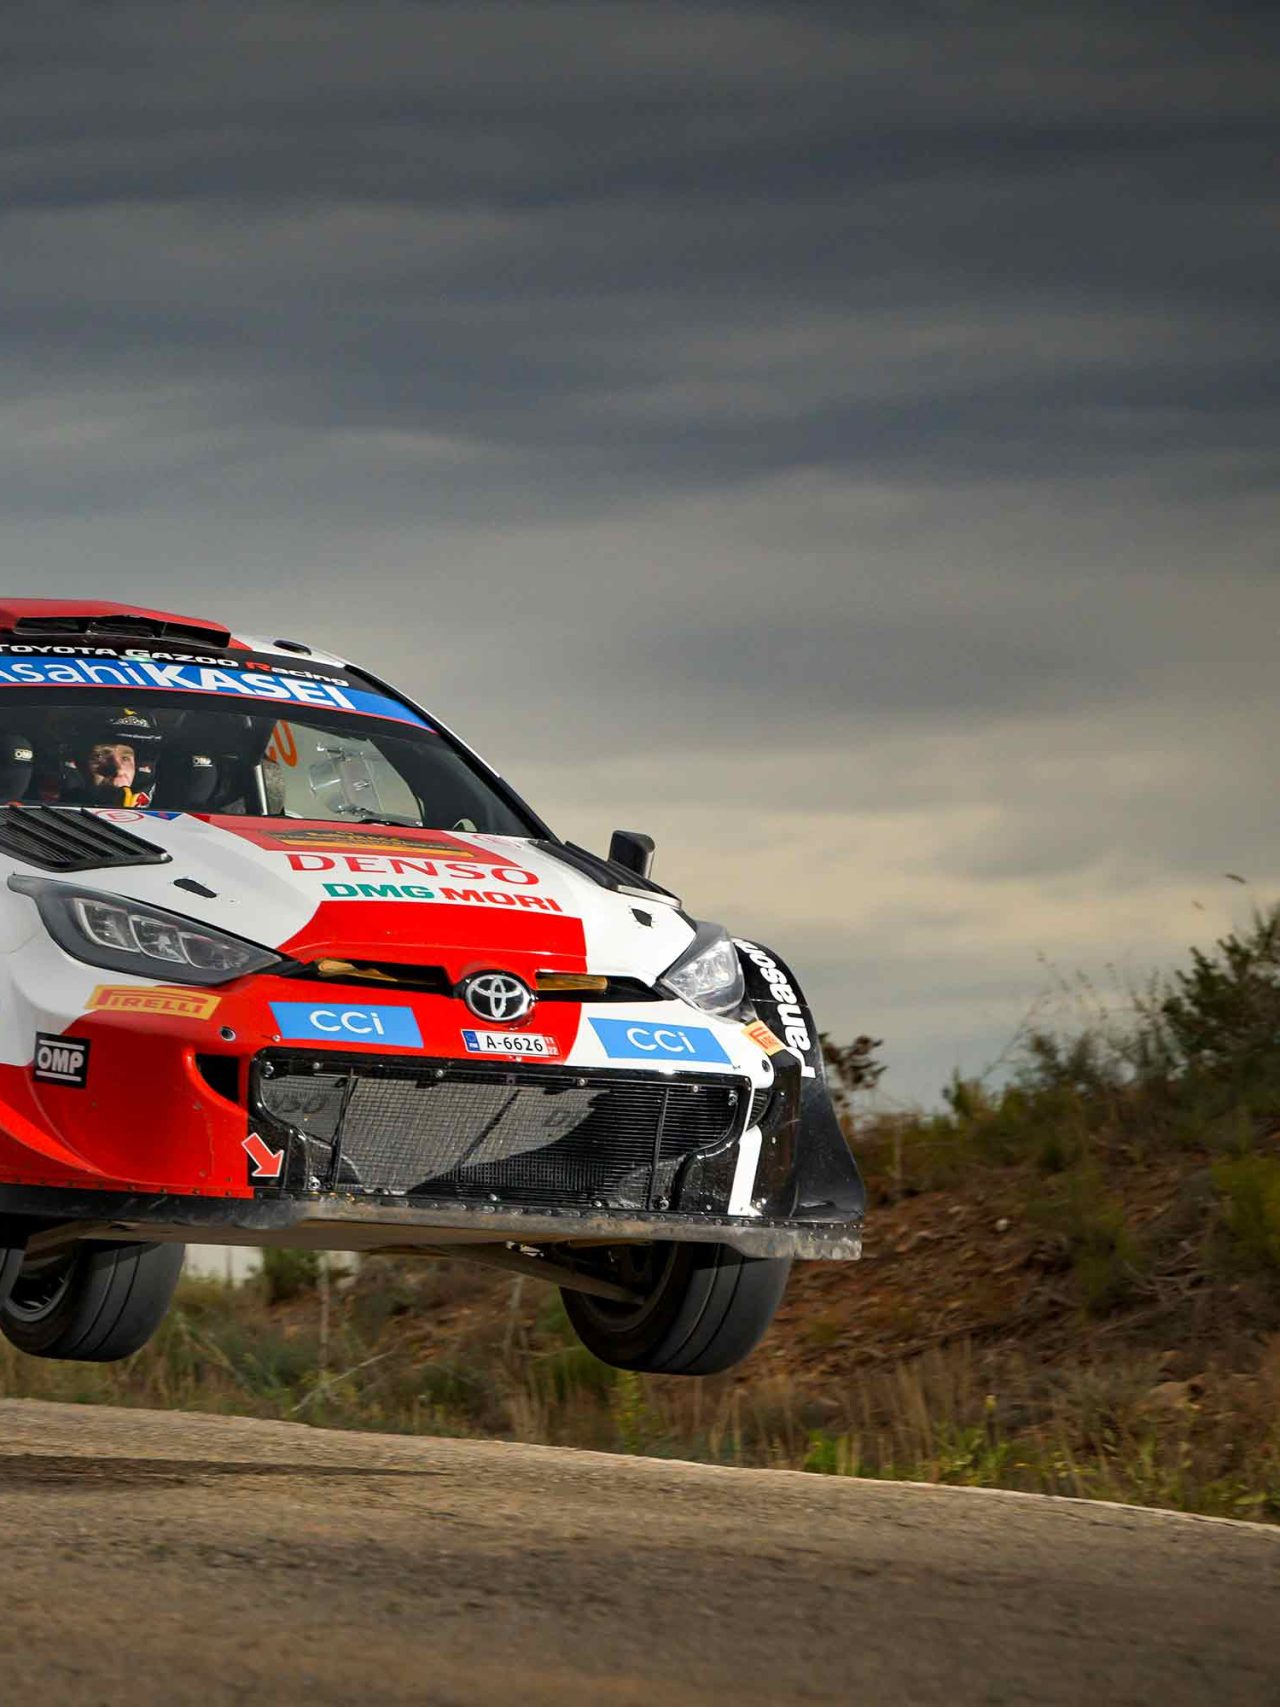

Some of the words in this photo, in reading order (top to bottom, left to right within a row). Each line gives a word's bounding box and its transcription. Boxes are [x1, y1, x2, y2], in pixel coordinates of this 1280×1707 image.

[125, 649, 239, 667] GAZOO
[244, 661, 350, 687] Racing
[284, 853, 540, 886] DENSO
[322, 882, 435, 899] DMG
[439, 887, 564, 913] MORI
[95, 988, 209, 1014] PIRELLI
[732, 937, 816, 1078] Panason
[485, 1034, 544, 1052] A-6626
[37, 1045, 84, 1074] OMP
